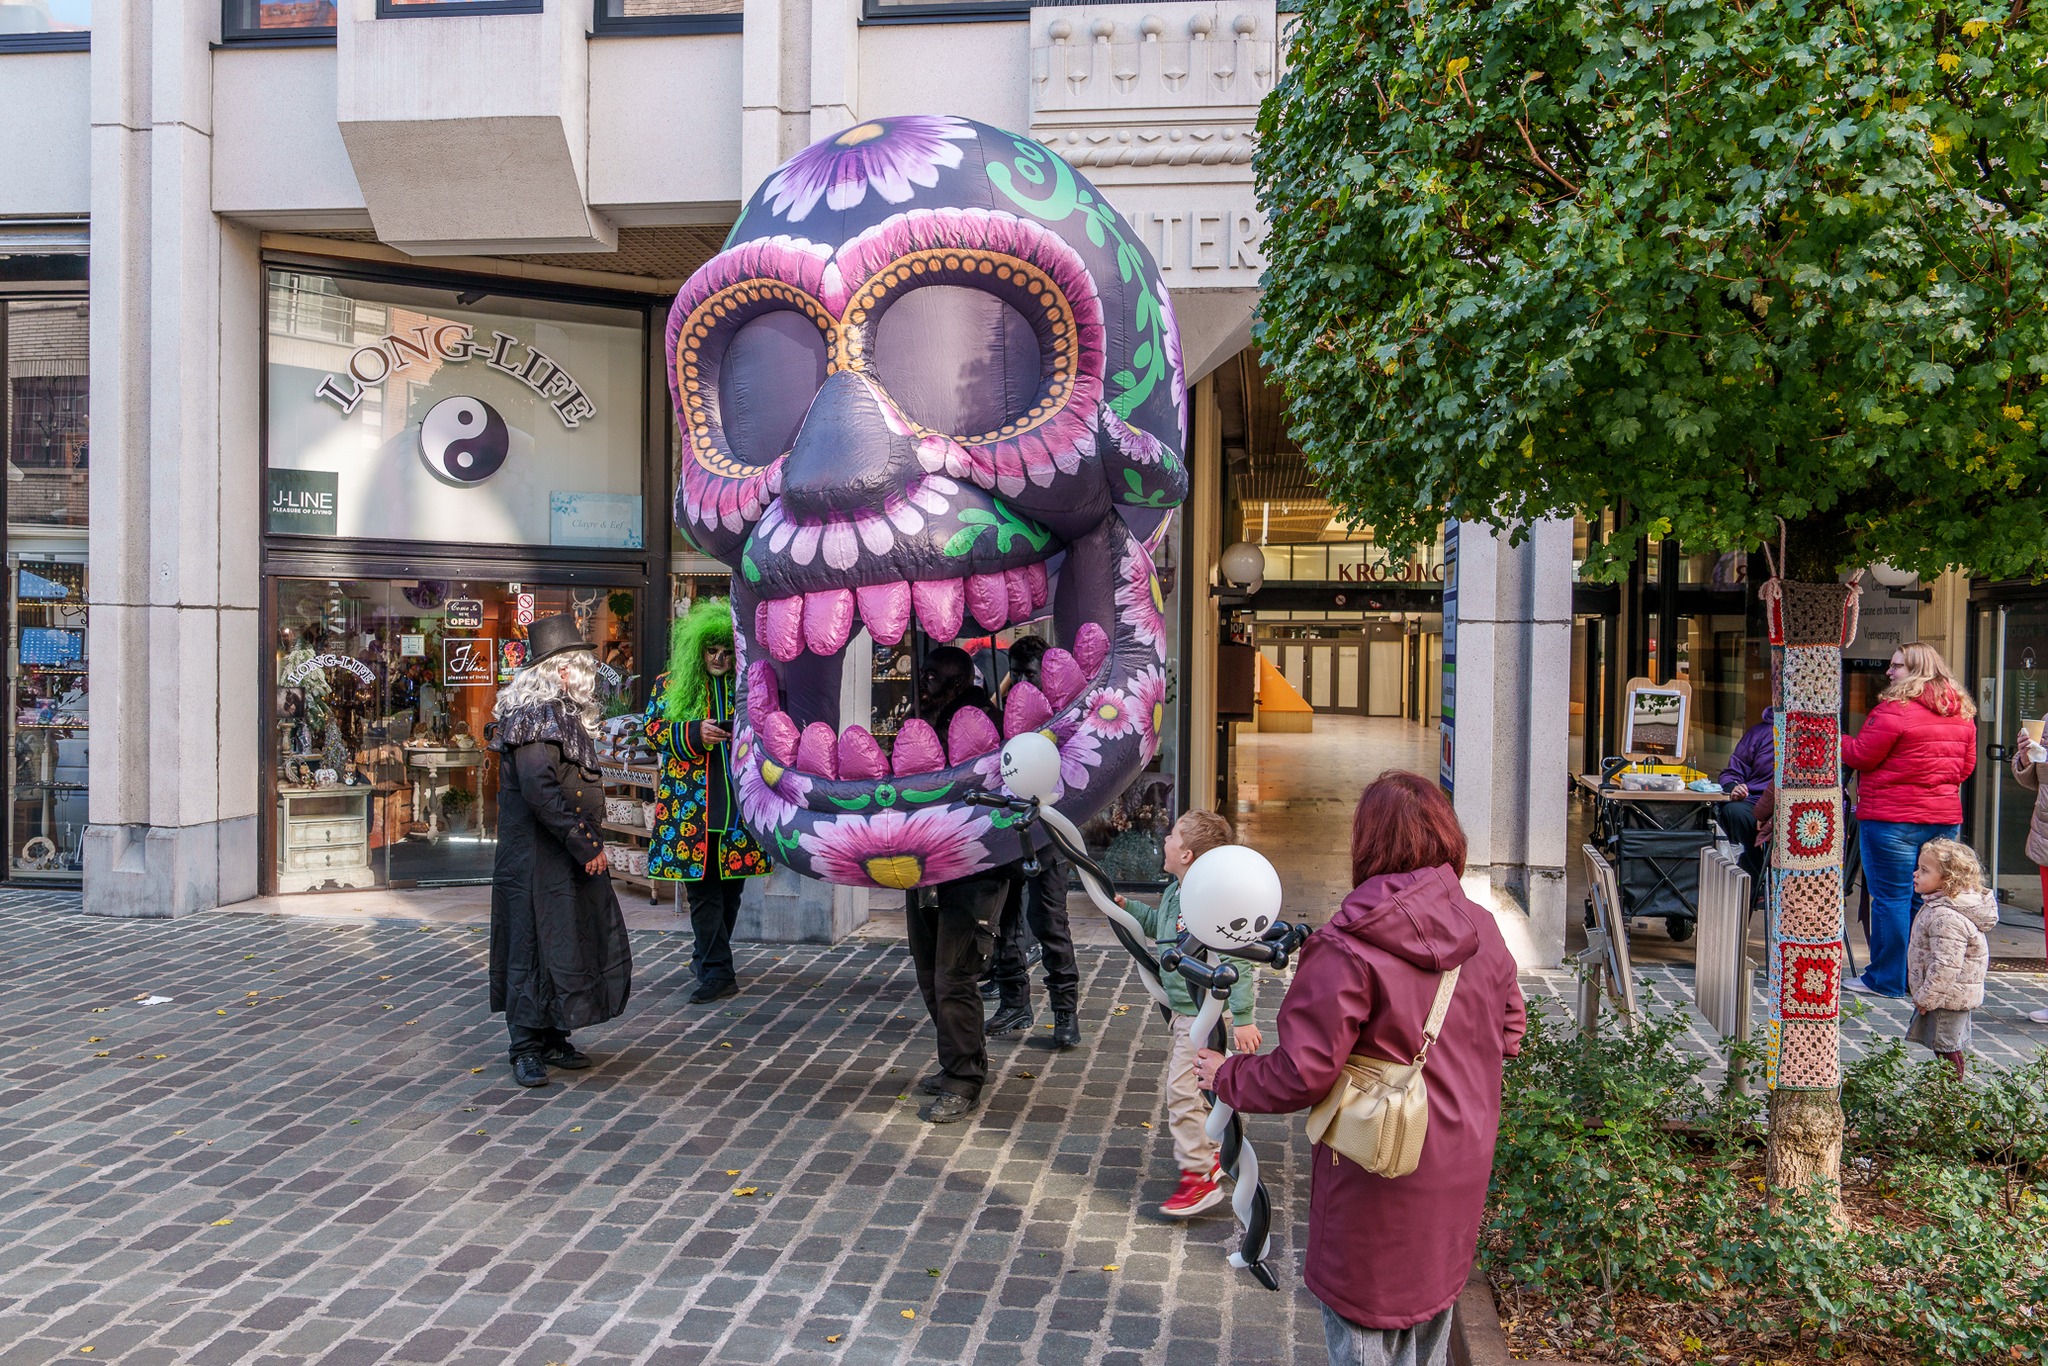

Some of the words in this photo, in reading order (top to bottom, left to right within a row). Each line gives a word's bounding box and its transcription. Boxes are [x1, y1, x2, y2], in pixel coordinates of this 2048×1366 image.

[1133, 210, 1260, 271] TER
[315, 323, 597, 429] LONG-LIFE
[273, 490, 333, 509] J-LINE
[571, 519, 598, 531] Clayre
[600, 520, 607, 529] &
[610, 520, 625, 530] Eef
[450, 617, 478, 626] OPEN
[287, 653, 377, 685] LONG-LIFE
